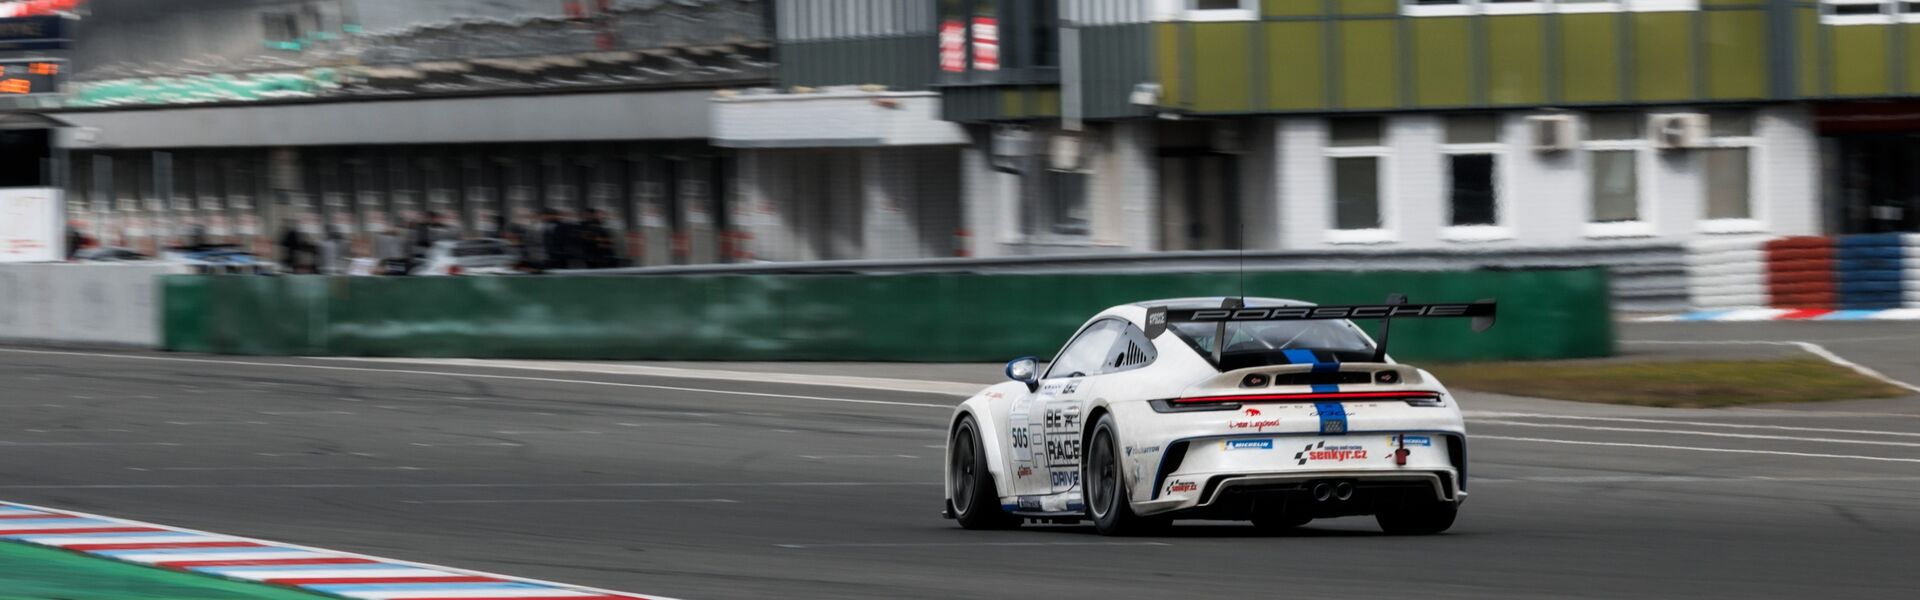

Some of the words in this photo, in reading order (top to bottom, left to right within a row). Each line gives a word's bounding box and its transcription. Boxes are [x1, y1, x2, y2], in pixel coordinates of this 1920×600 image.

[1190, 304, 1469, 320] PORSCHE
[1046, 409, 1062, 428] BE
[1012, 427, 1029, 448] 505
[1047, 440, 1080, 460] RACE
[1309, 449, 1368, 462] senkyr.cz
[1051, 471, 1080, 487] DRIVE
